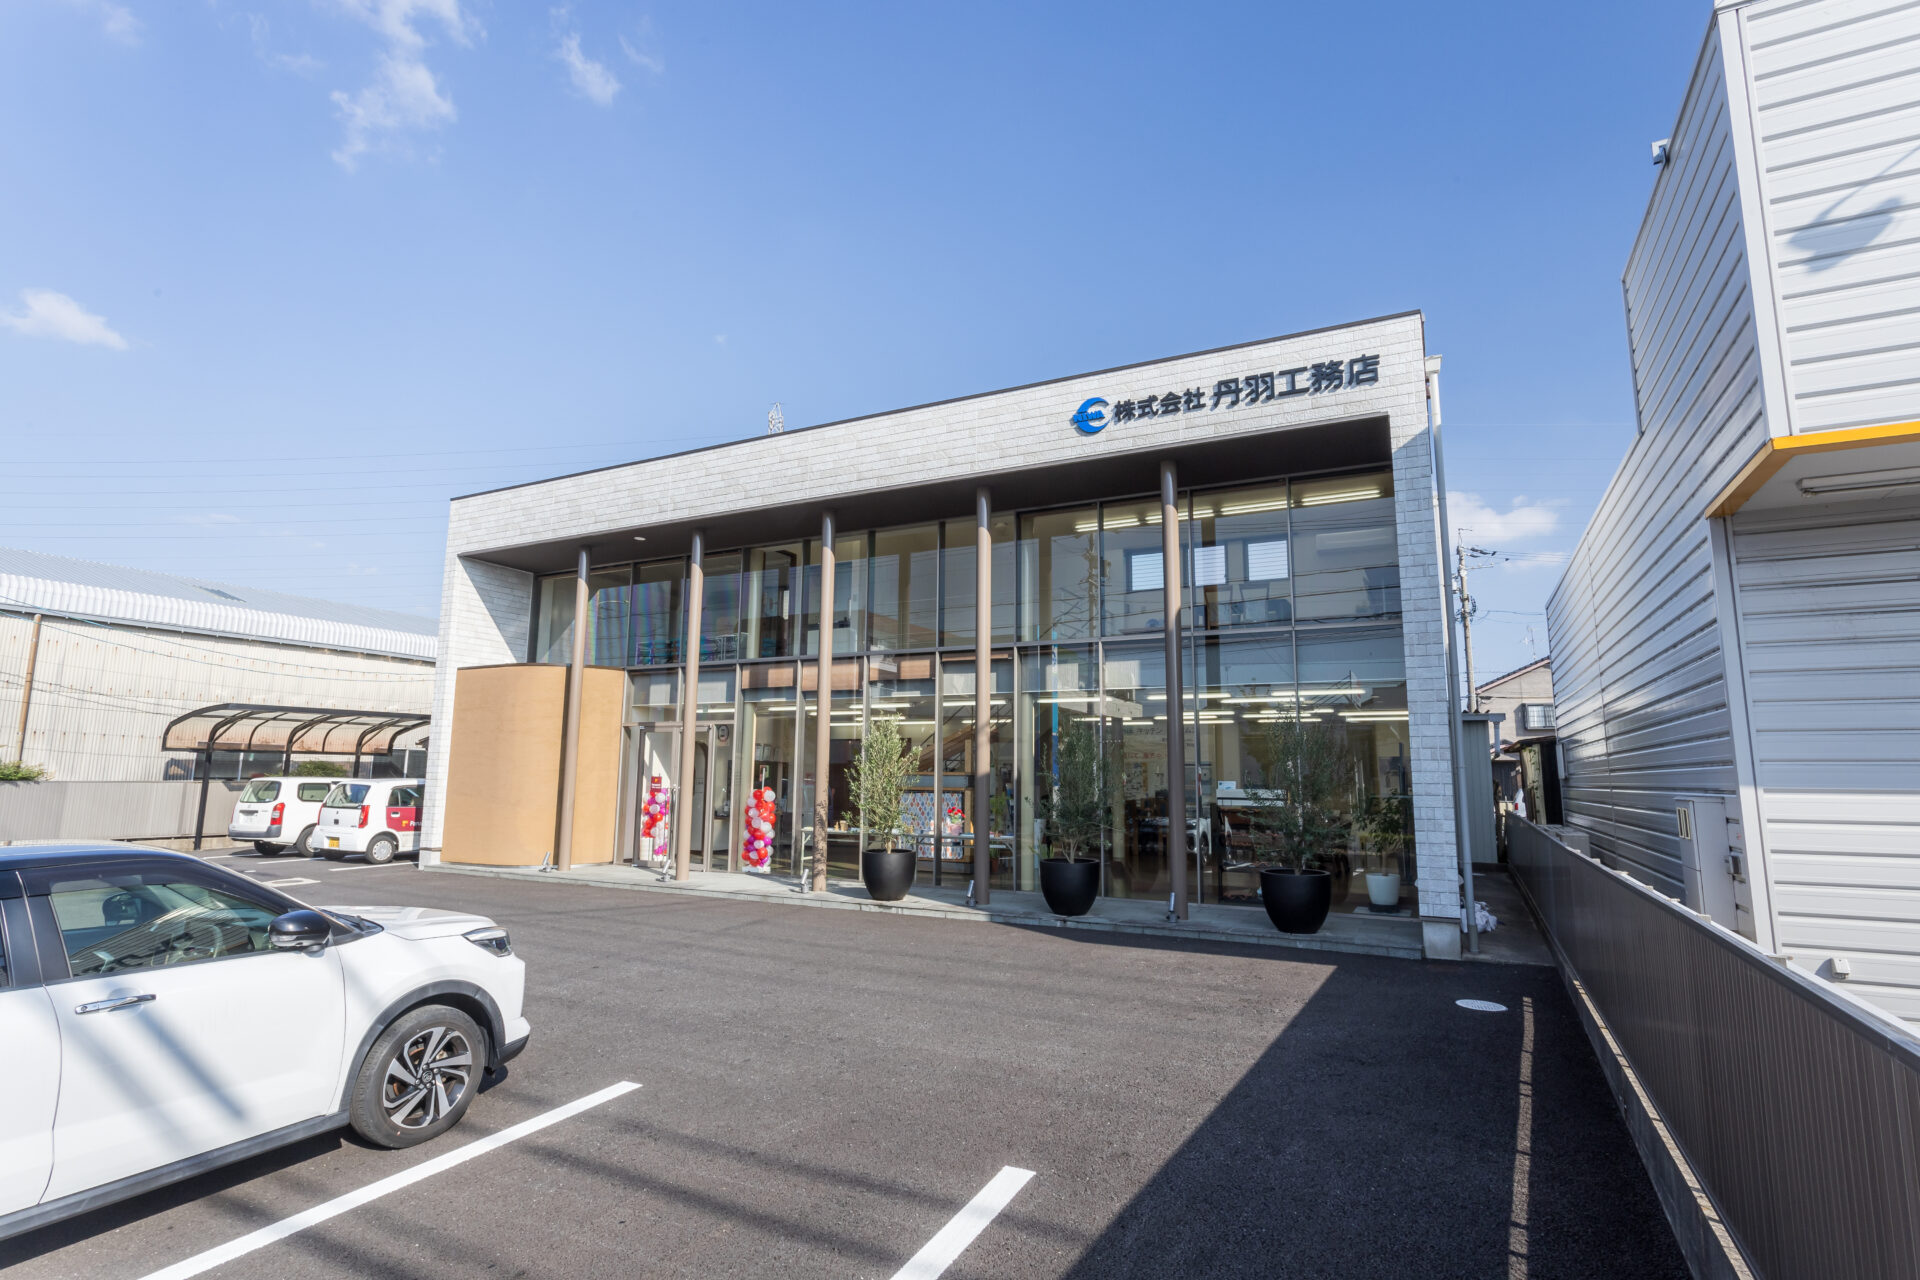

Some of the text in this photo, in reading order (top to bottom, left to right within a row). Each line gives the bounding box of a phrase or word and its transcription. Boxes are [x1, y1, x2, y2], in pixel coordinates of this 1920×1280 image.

[1114, 354, 1380, 422] 株式会社丹羽工務店
[1073, 410, 1105, 423] NIWA
